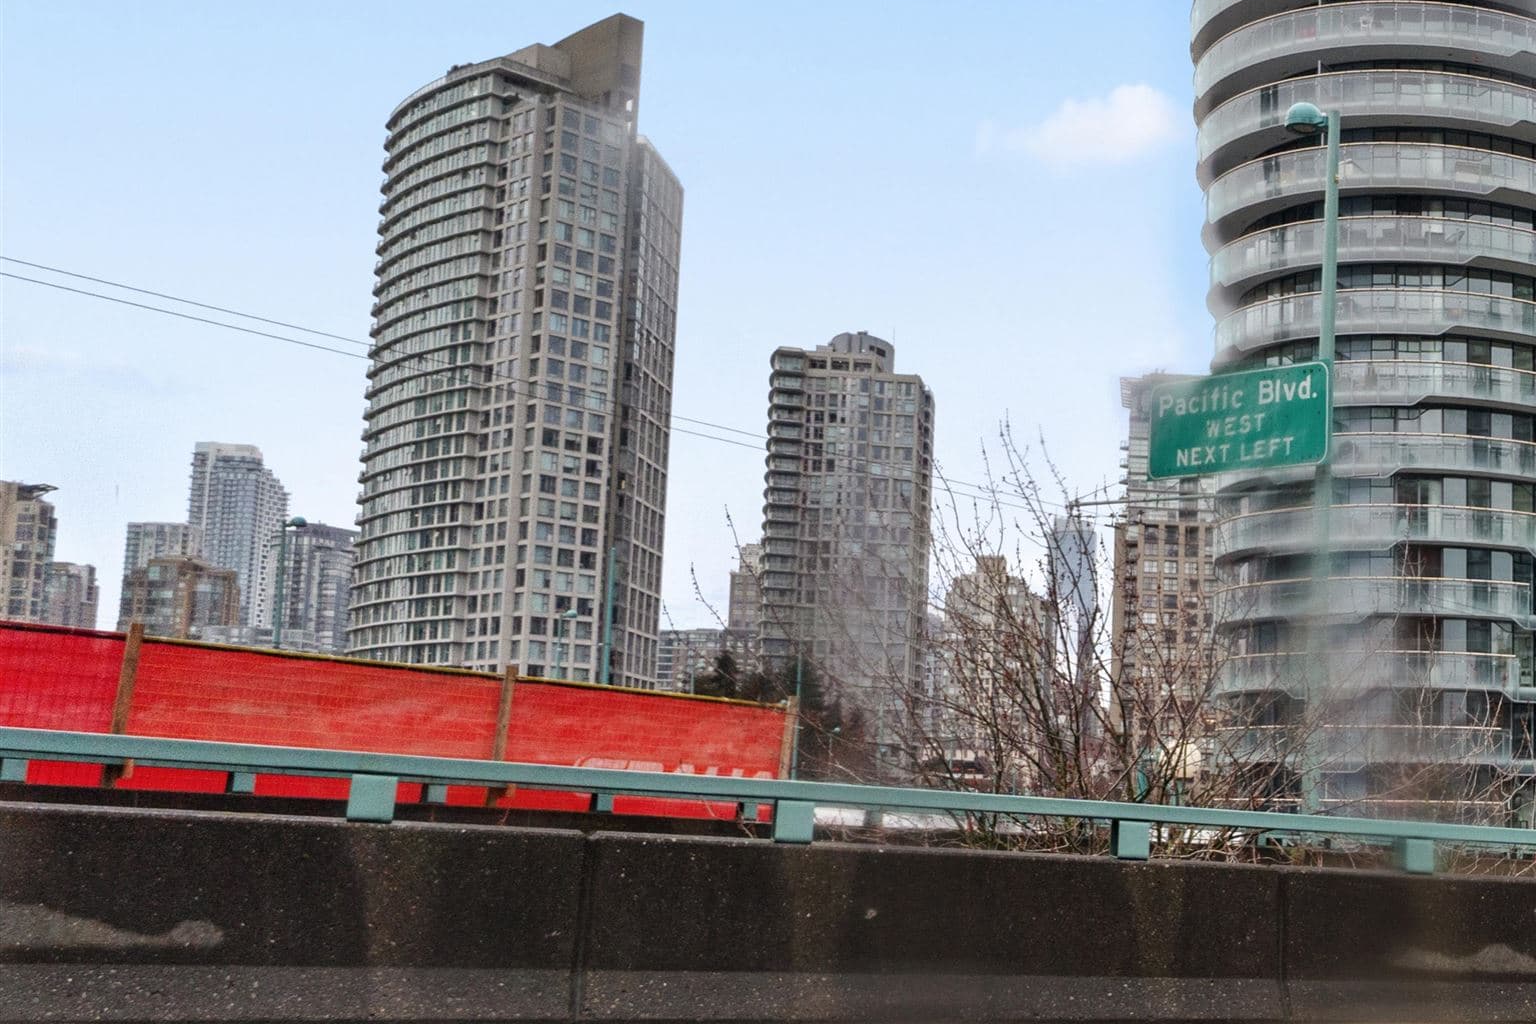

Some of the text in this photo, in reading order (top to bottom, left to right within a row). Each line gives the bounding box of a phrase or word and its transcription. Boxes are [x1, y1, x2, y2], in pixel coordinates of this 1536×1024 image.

[1159, 375, 1317, 417] Pacific Blvd.
[1206, 413, 1266, 438] WEST
[1176, 436, 1294, 467] NEXT LEFT
